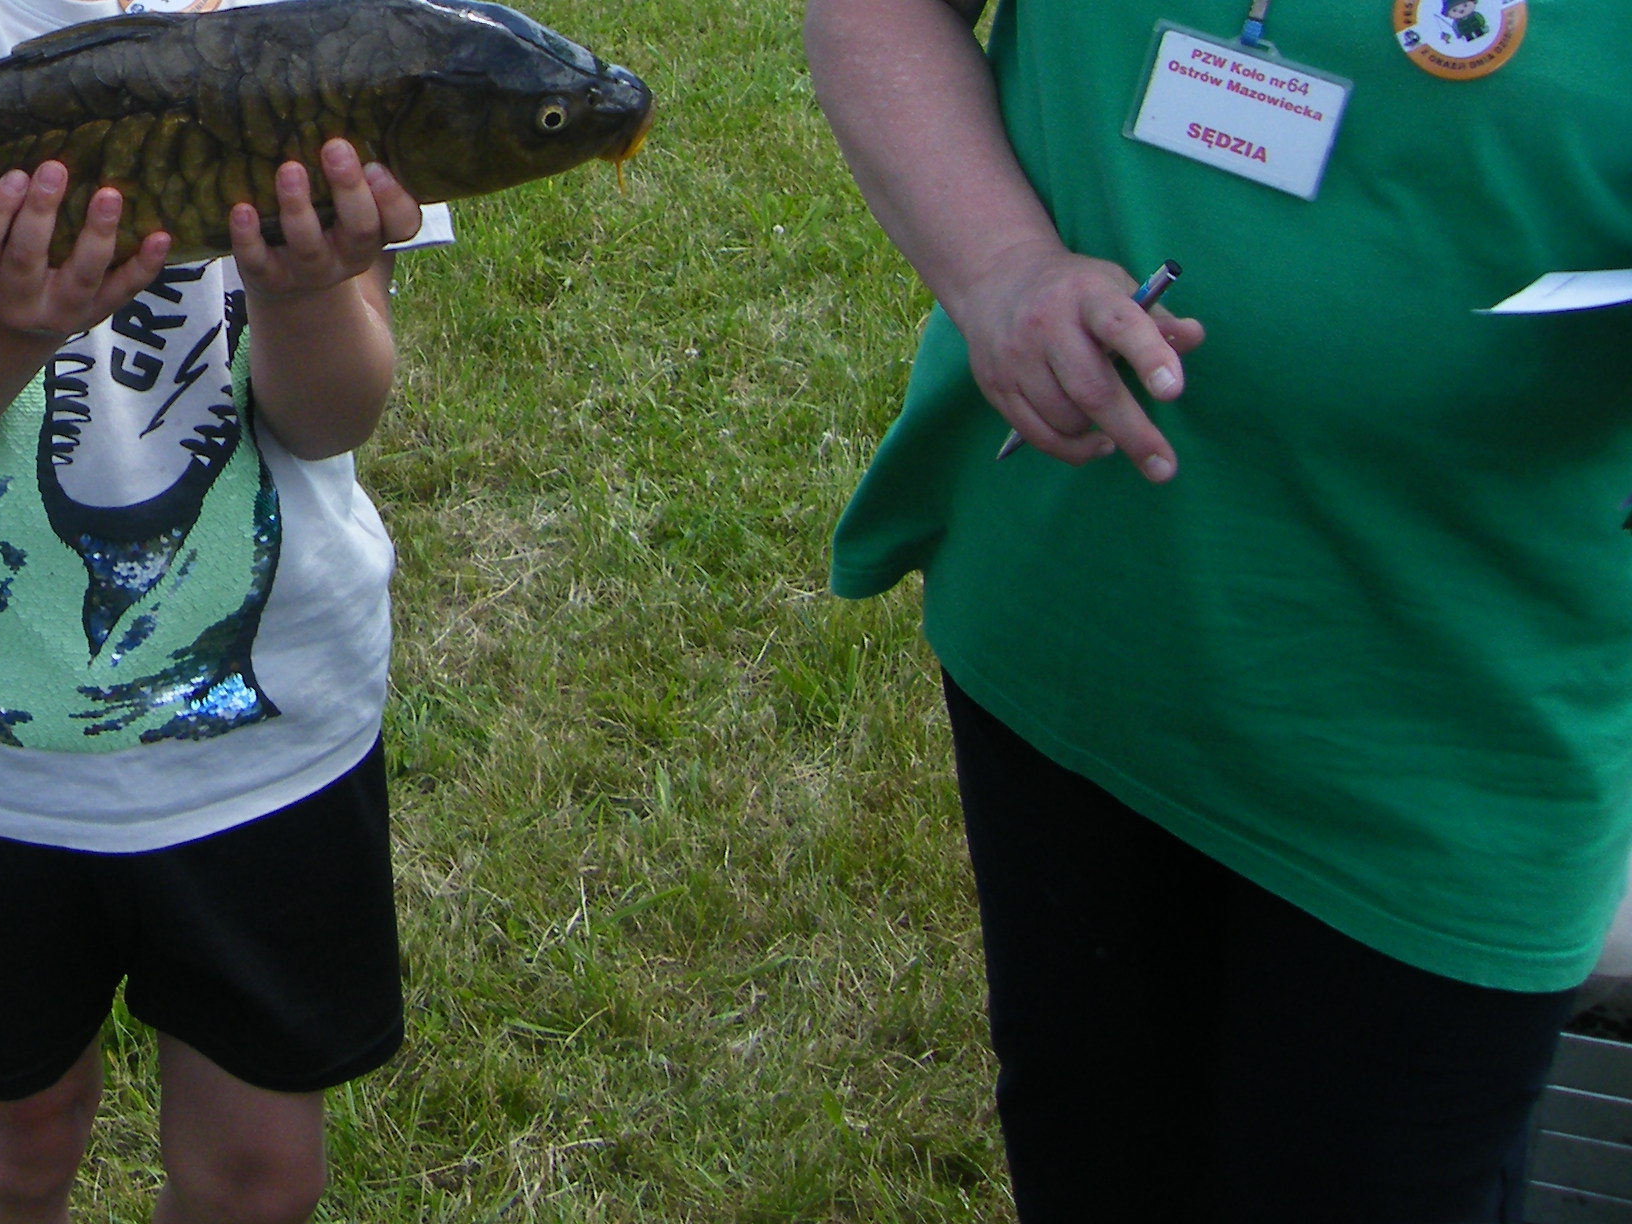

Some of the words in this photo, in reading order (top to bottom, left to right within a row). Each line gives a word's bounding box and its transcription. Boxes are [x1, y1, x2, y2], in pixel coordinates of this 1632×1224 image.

[1191, 48, 1228, 69] PZW
[1230, 61, 1266, 82] Koło
[1168, 59, 1223, 87] Ostrów
[1226, 79, 1324, 122] Mazowiecka
[1186, 122, 1268, 163] SĘDZIA
